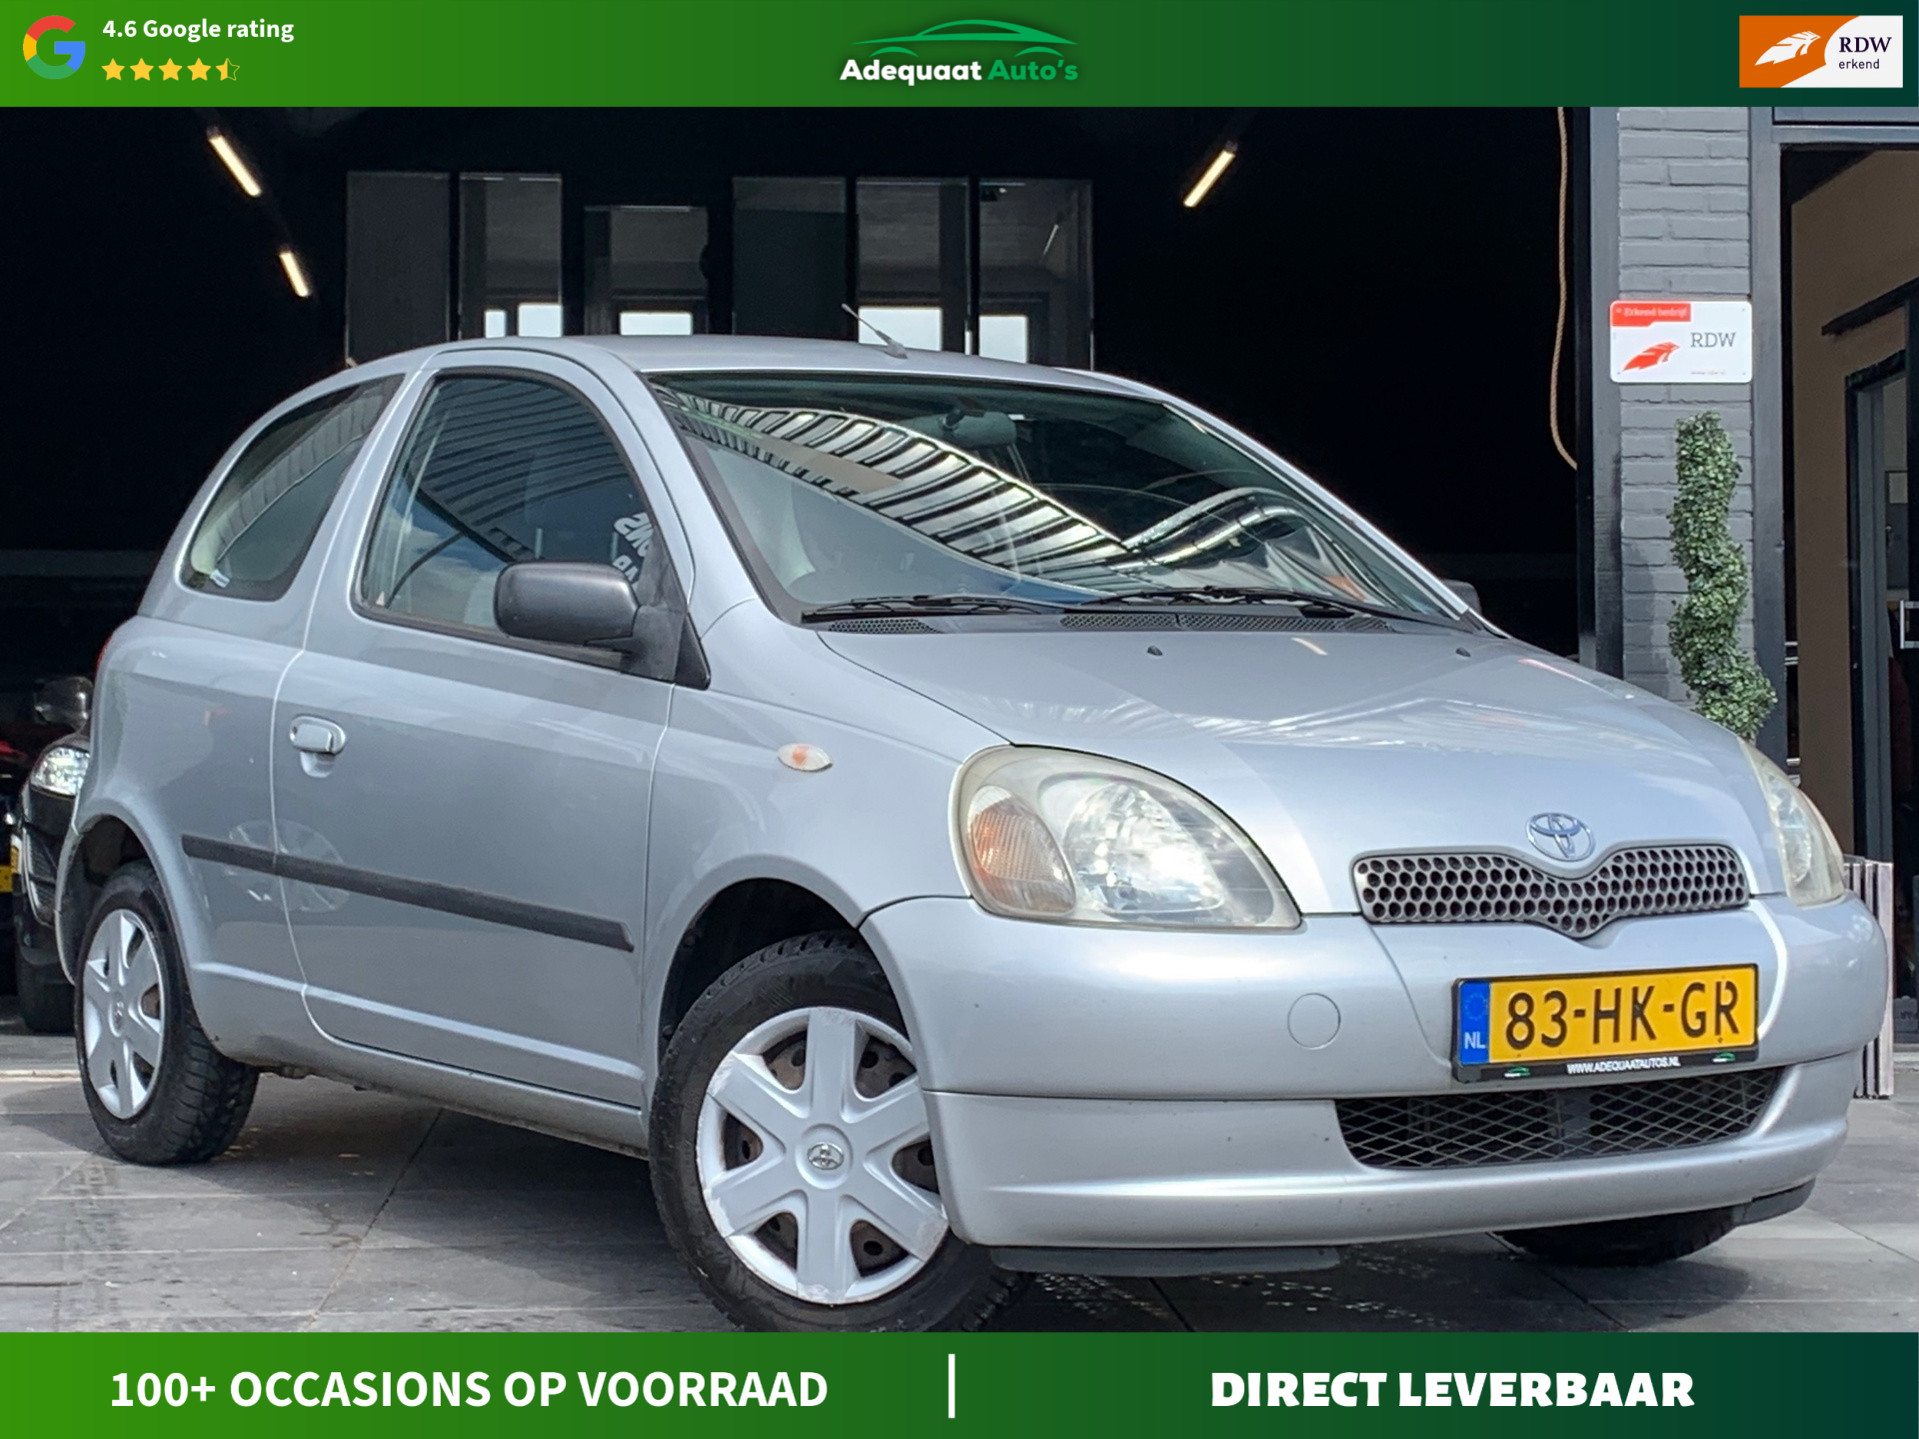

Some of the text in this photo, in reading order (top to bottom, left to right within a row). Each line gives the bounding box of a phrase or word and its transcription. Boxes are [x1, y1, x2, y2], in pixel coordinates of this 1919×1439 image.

[1690, 332, 1736, 348] RDW
[1505, 980, 1740, 1051] 83-HK-GR
[1464, 1031, 1486, 1050] NL
[1566, 1056, 1681, 1075] WWW.ADEQUAATAUTOS.NL
